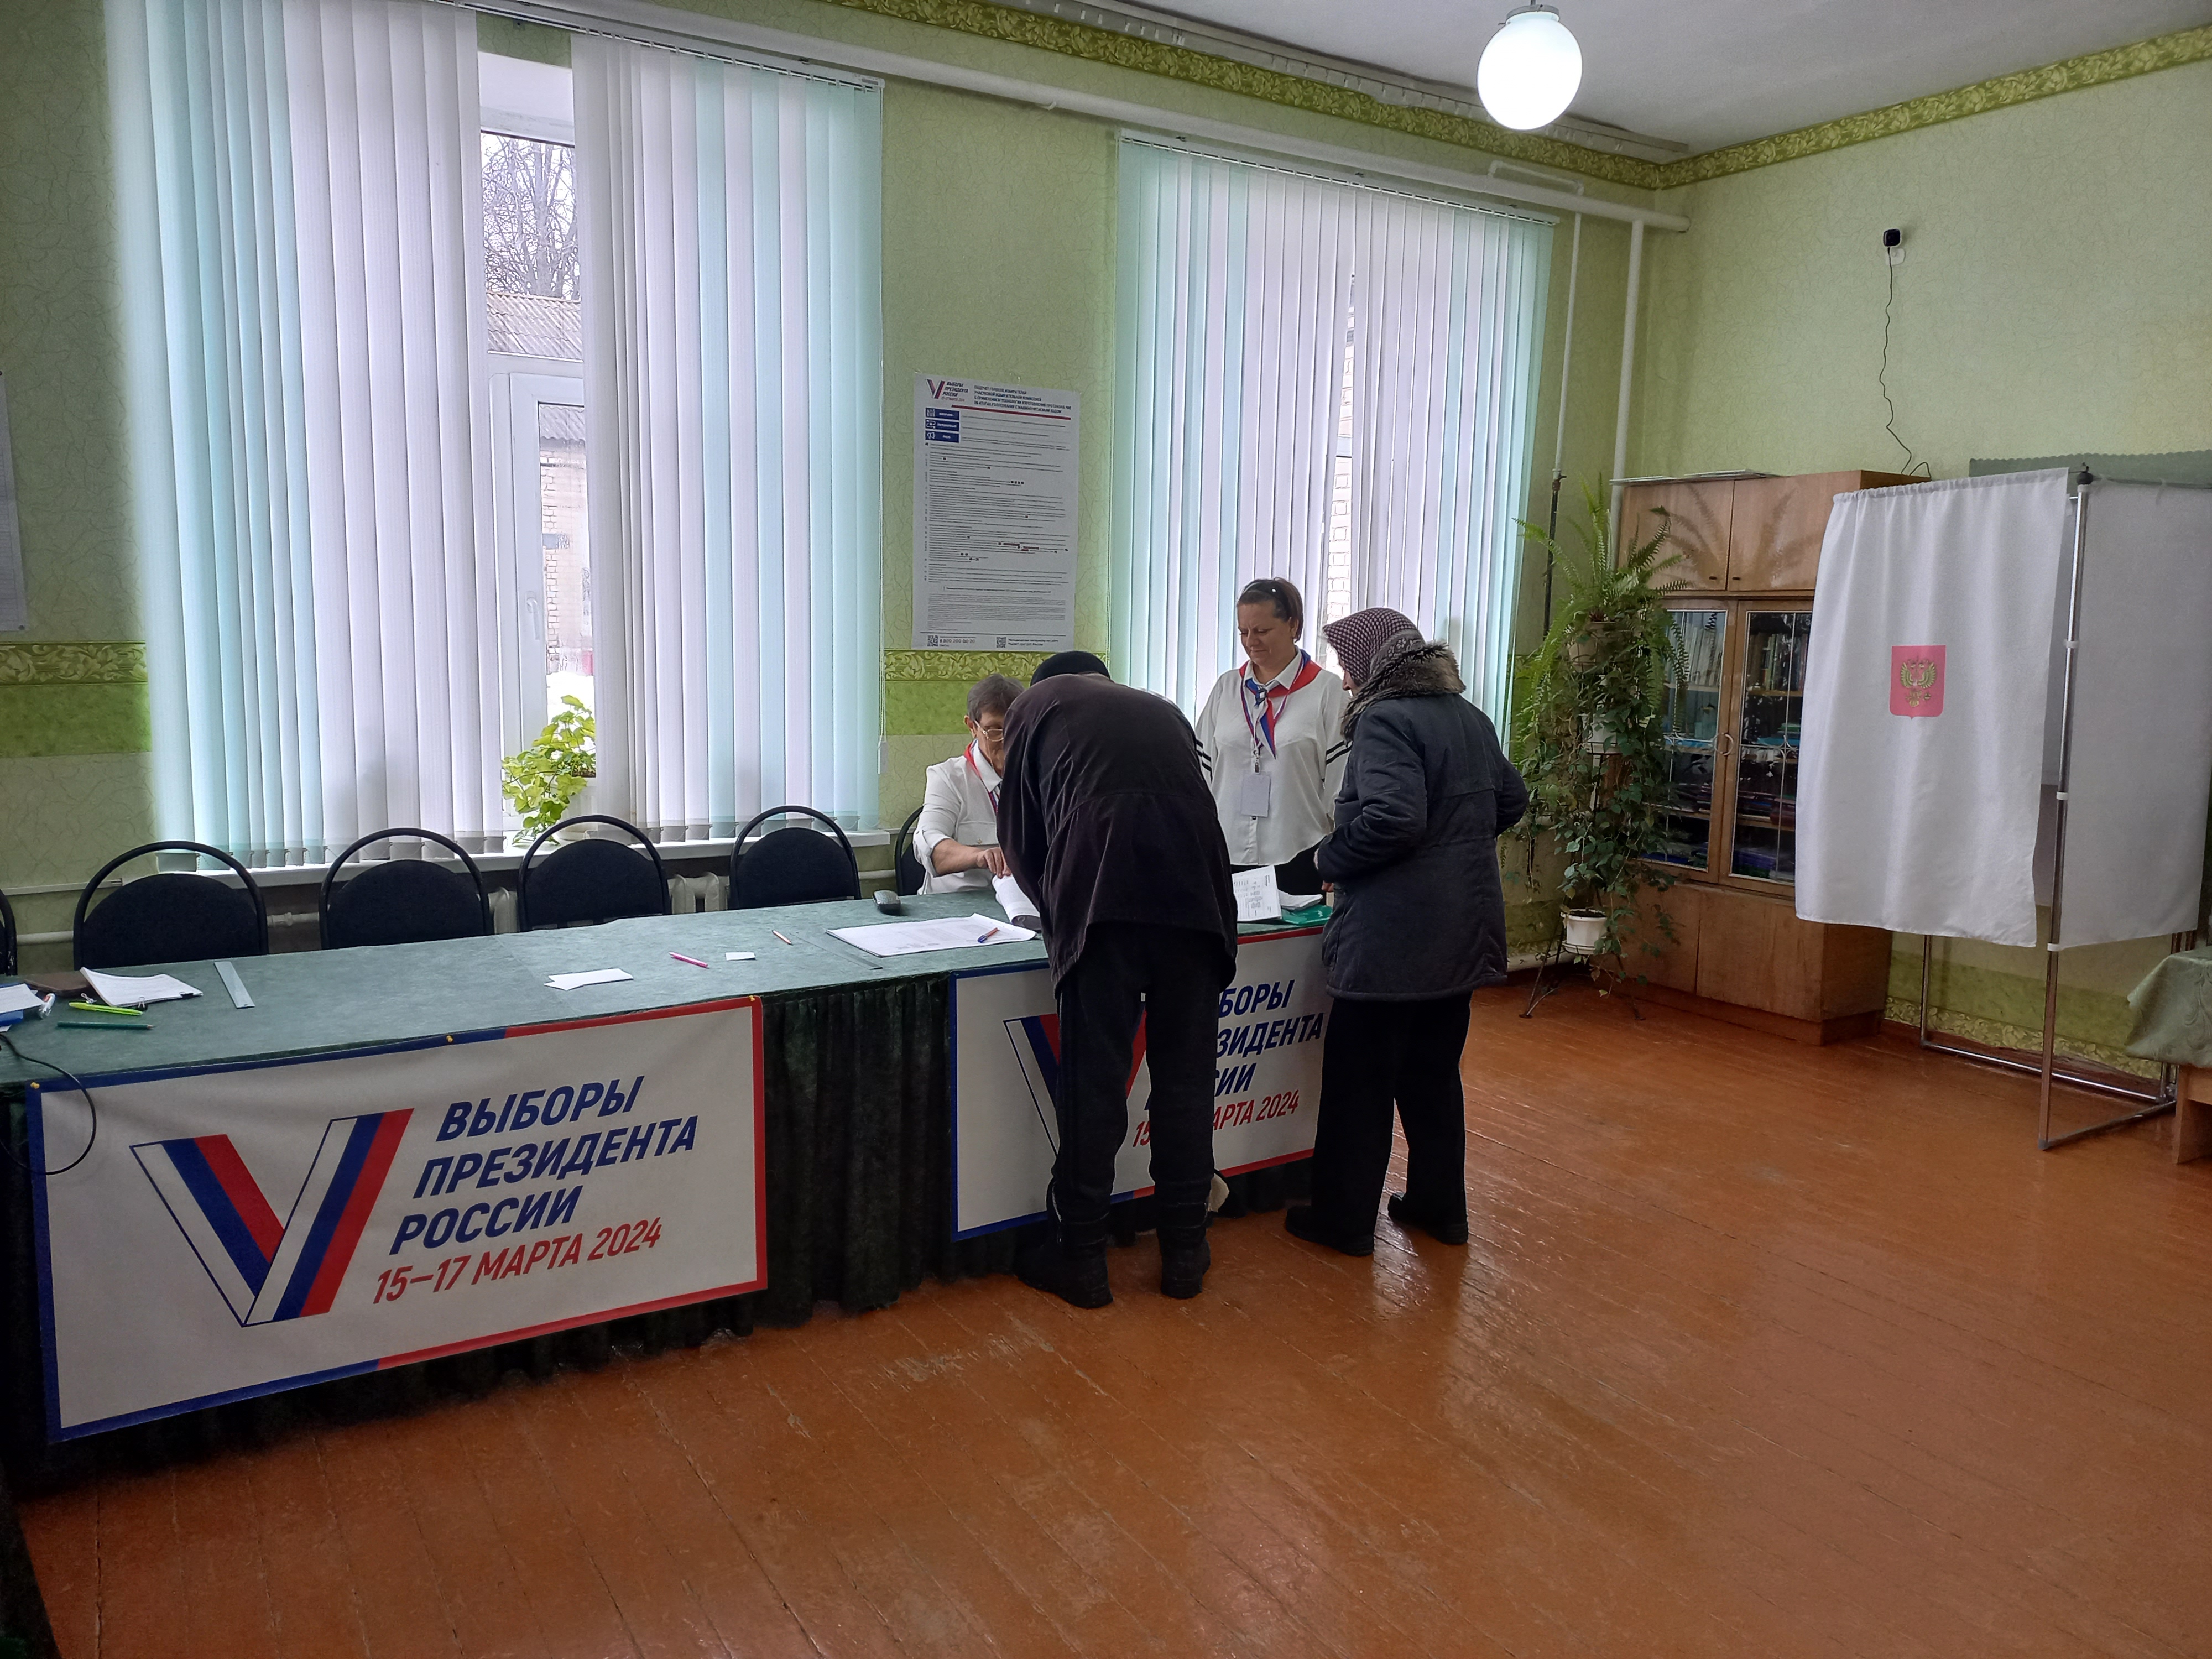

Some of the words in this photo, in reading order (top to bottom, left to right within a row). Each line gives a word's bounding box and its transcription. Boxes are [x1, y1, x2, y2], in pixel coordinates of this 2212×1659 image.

[1219, 979, 1295, 1018] БОРЫ
[1217, 1013, 1324, 1058] ЗИДЕНТА
[436, 1076, 645, 1141] ВЫБОРЫ
[1213, 1099, 1255, 1130] АРТА
[1255, 1089, 1300, 1121] 2024
[413, 1115, 698, 1199] ПРЕЗИДЕНТА
[389, 1185, 583, 1255] РОССИИ
[471, 1233, 583, 1285] МАРТА
[587, 1217, 661, 1261] 2024
